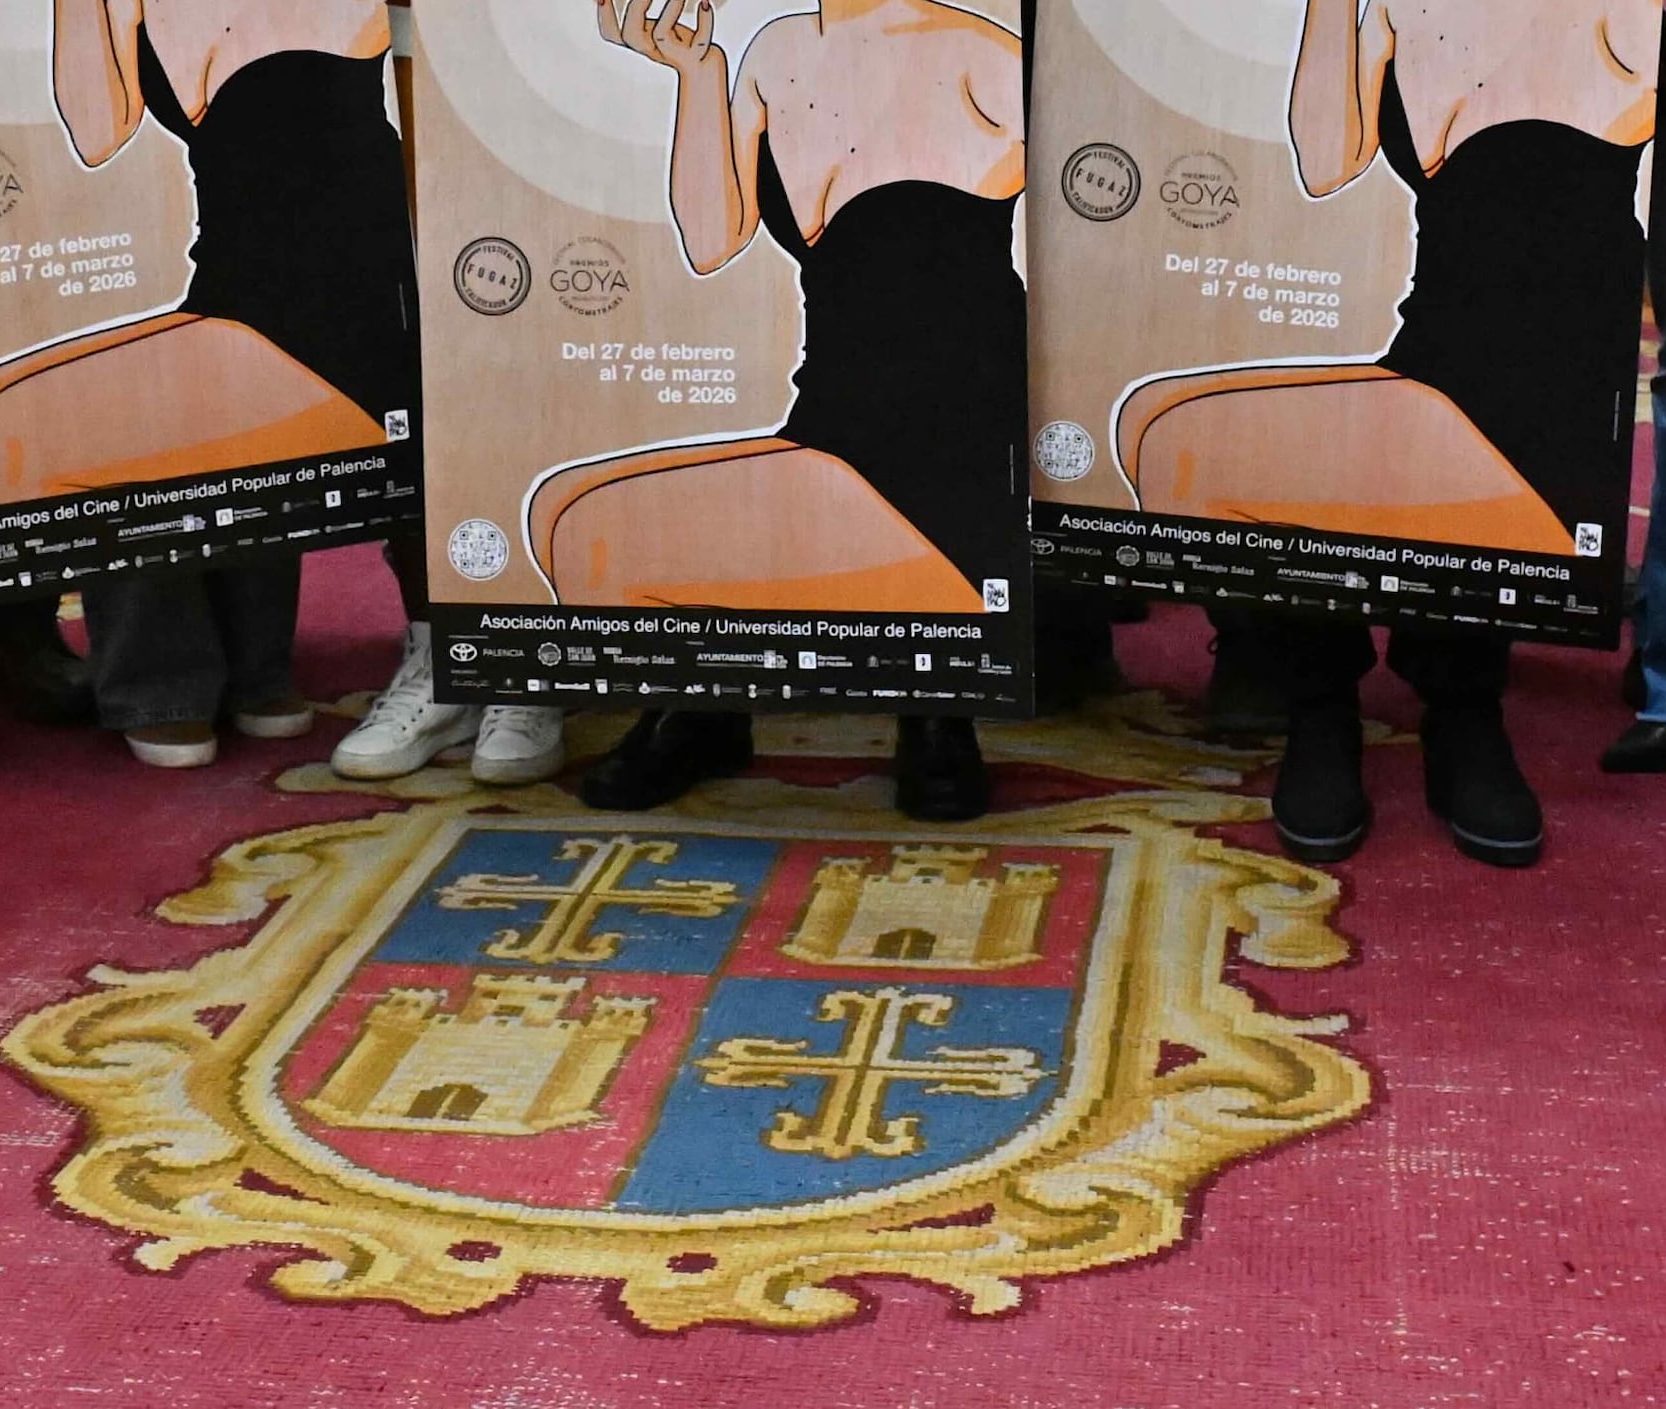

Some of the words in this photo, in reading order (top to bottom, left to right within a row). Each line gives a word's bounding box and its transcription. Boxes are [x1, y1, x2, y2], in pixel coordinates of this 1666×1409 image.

[1076, 169, 1126, 197] FUGAZ
[1160, 181, 1240, 208] GOYA
[0, 244, 21, 264] 27
[29, 242, 53, 259] de
[60, 233, 132, 254] febrero
[0, 268, 17, 284] al
[22, 264, 33, 280] 7
[41, 261, 65, 279] de
[71, 254, 133, 274] marzo
[467, 263, 518, 290] FUGAZ
[550, 269, 630, 292] GOYA
[1166, 254, 1198, 273] Del
[1204, 258, 1229, 275] 27
[1235, 261, 1259, 279] de
[1267, 263, 1341, 285] febrero
[59, 278, 83, 296] de
[90, 271, 136, 292] 2026
[1201, 279, 1218, 296] al
[1225, 281, 1237, 296] 7
[1243, 283, 1268, 301] de
[1275, 288, 1339, 306] marzo
[1259, 306, 1283, 323] de
[1291, 308, 1338, 328] 2026
[562, 343, 595, 359] Del
[601, 344, 624, 359] 27
[631, 344, 655, 360] de
[662, 344, 735, 360] febrero
[600, 366, 617, 381] al
[623, 366, 635, 381] 7
[641, 366, 666, 381] de
[672, 369, 735, 382] marzo
[658, 387, 683, 403] de
[689, 387, 736, 404] 2026
[54, 503, 79, 522] del
[83, 498, 120, 516] Cine
[134, 481, 228, 508] Universidad
[232, 471, 291, 494] Popular
[296, 468, 315, 483] de
[320, 456, 386, 478] Palencia
[1060, 514, 1147, 536] Asociación
[1151, 523, 1211, 543] Amigos
[1216, 530, 1241, 546] del
[1245, 533, 1283, 551] Cine
[1299, 538, 1396, 562] Universidad
[1402, 549, 1466, 570] Popular
[1471, 557, 1493, 572] de
[1498, 559, 1570, 580] Palencia
[1277, 568, 1344, 582] AYUNTAMIENTO
[480, 614, 566, 630] Asociación
[570, 615, 630, 635] Amigos
[634, 618, 659, 632] del
[662, 618, 700, 634] Cine
[716, 619, 811, 635] Universidad
[817, 621, 879, 639] Popular
[884, 622, 905, 637] de
[911, 623, 982, 639] Palencia
[697, 653, 763, 662] AYUNTAMIENTO
